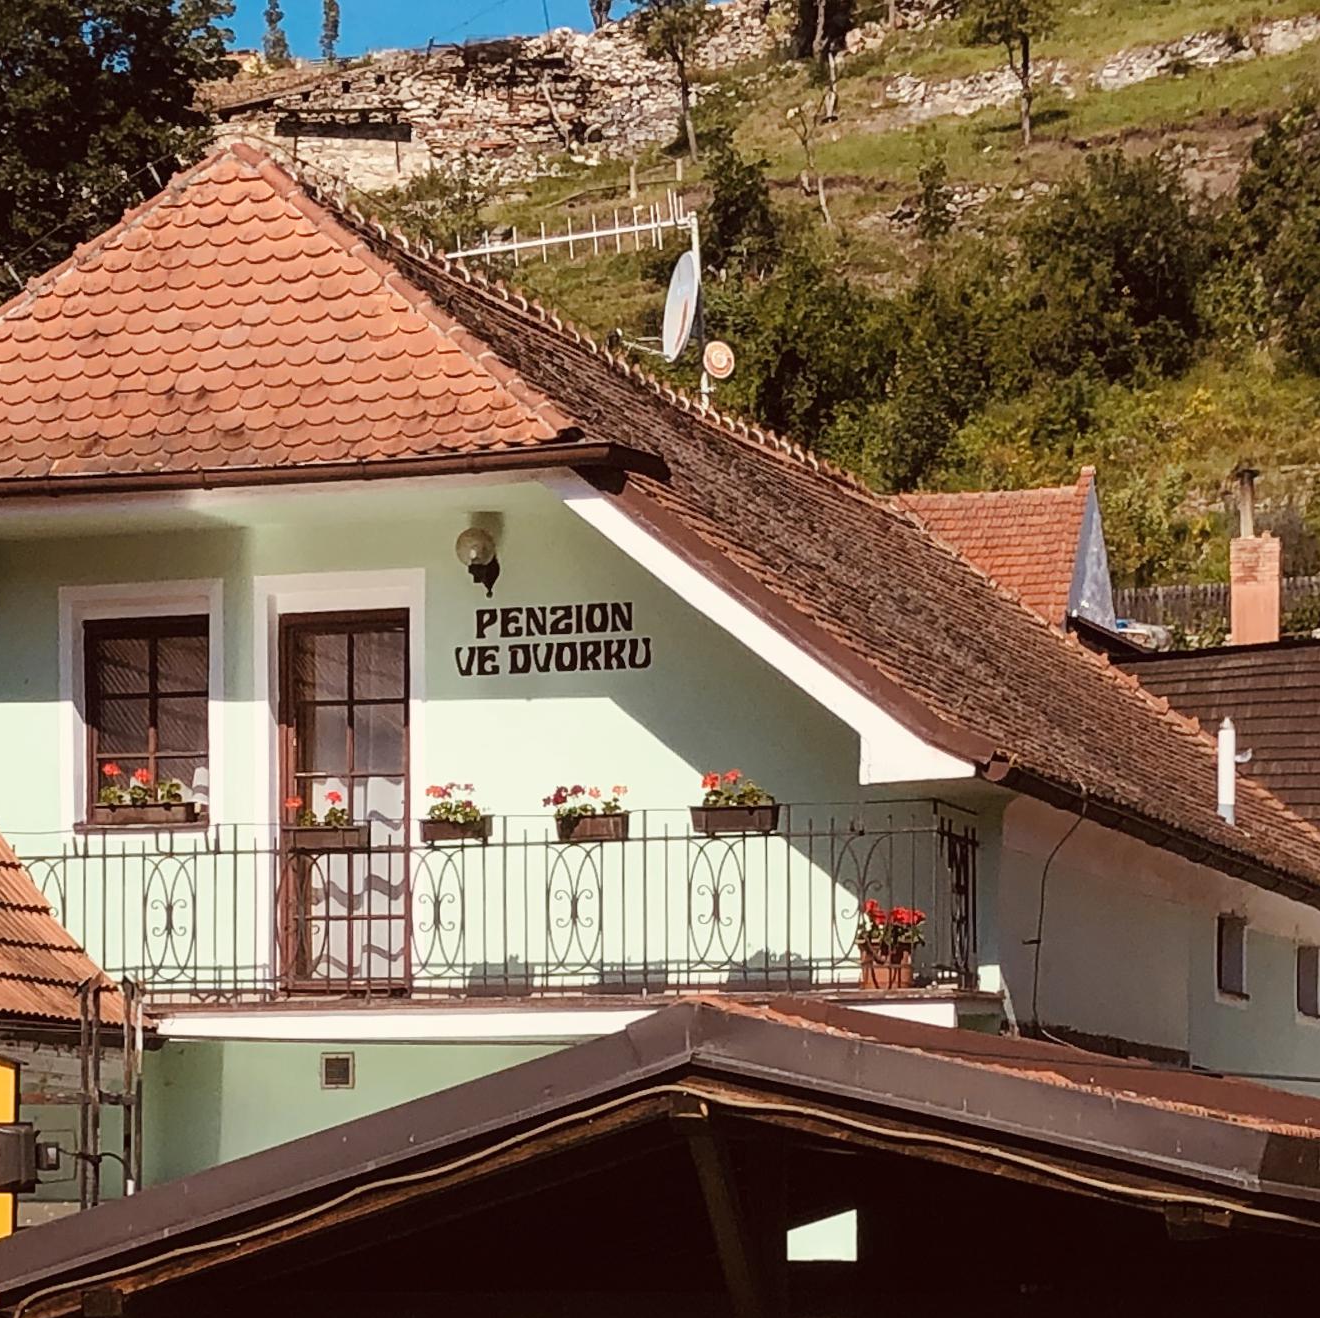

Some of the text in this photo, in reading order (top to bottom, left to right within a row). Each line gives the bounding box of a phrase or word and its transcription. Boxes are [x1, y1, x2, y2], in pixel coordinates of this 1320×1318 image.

[475, 602, 633, 639] PENZION
[455, 637, 652, 676] VE DVORKU
